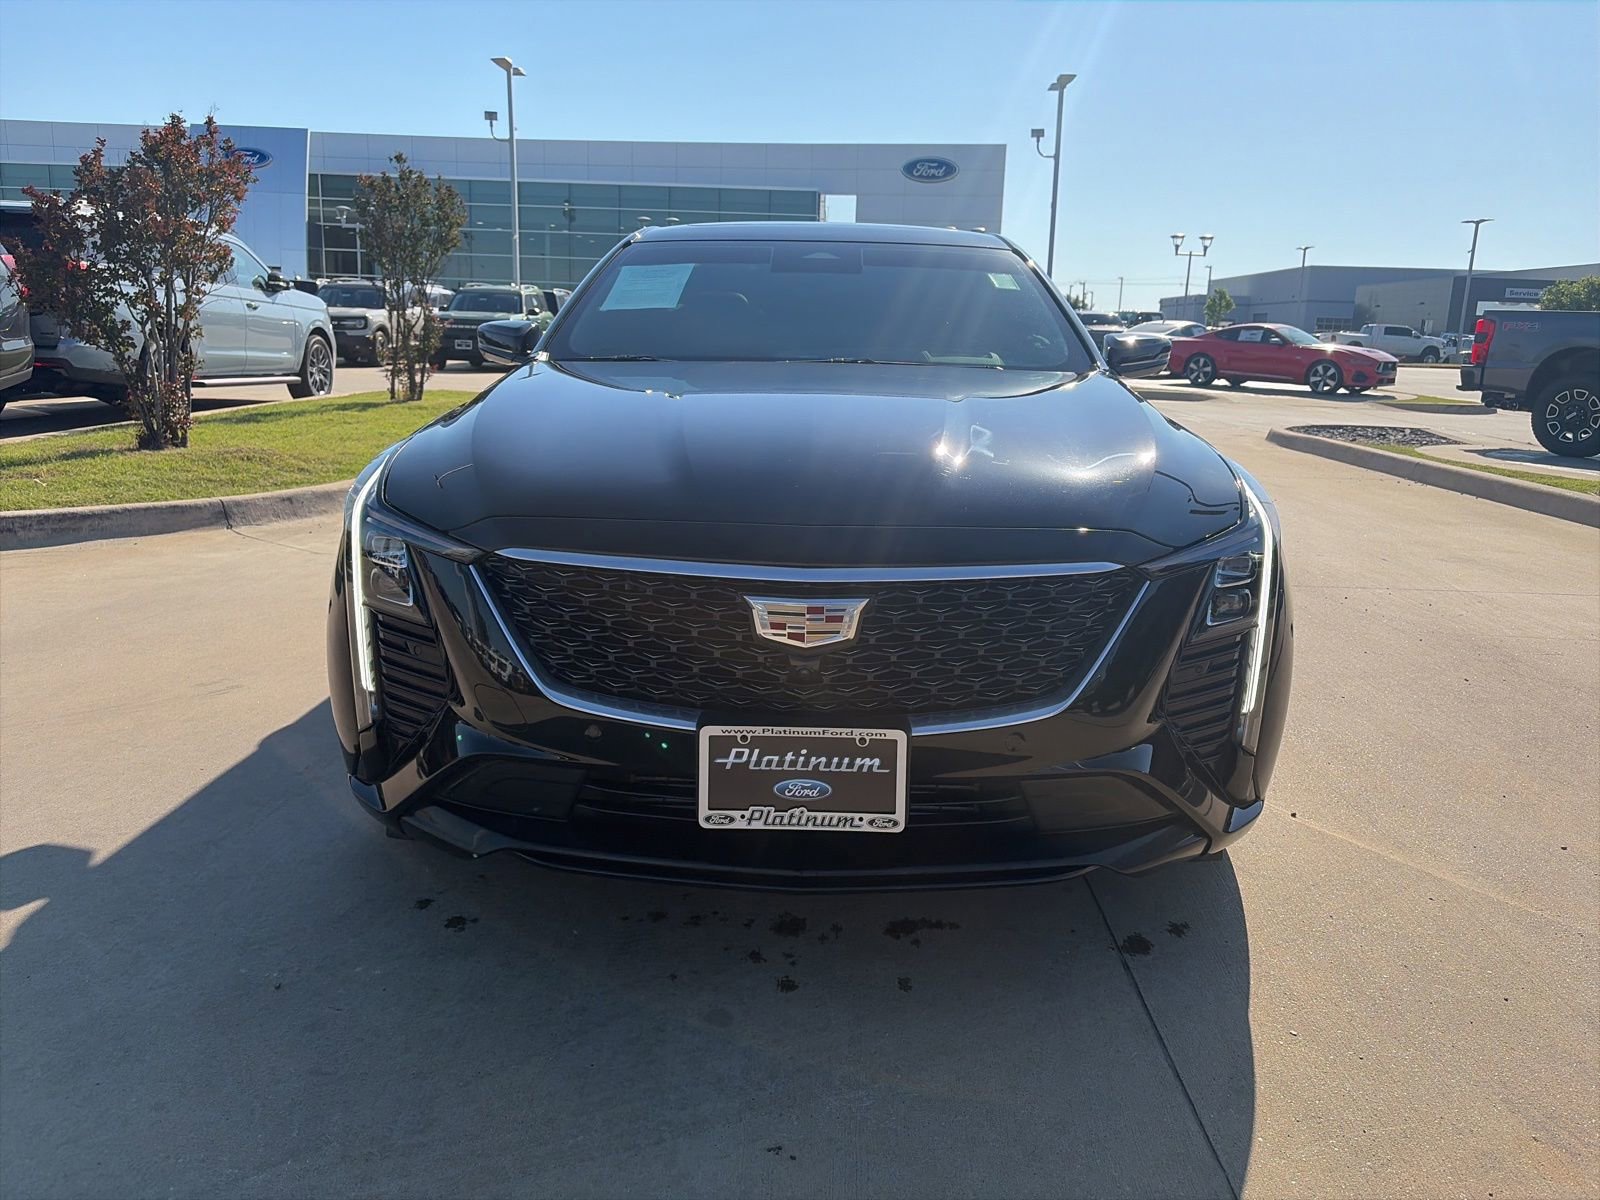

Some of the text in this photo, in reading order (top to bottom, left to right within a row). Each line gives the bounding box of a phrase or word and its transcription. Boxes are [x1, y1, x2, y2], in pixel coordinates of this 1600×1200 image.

[913, 162, 946, 177] Ford
[721, 728, 887, 738] www.PlatinumFord.com
[714, 748, 890, 773] Platinum
[785, 782, 820, 798] Ford
[747, 809, 864, 828] Platinum
